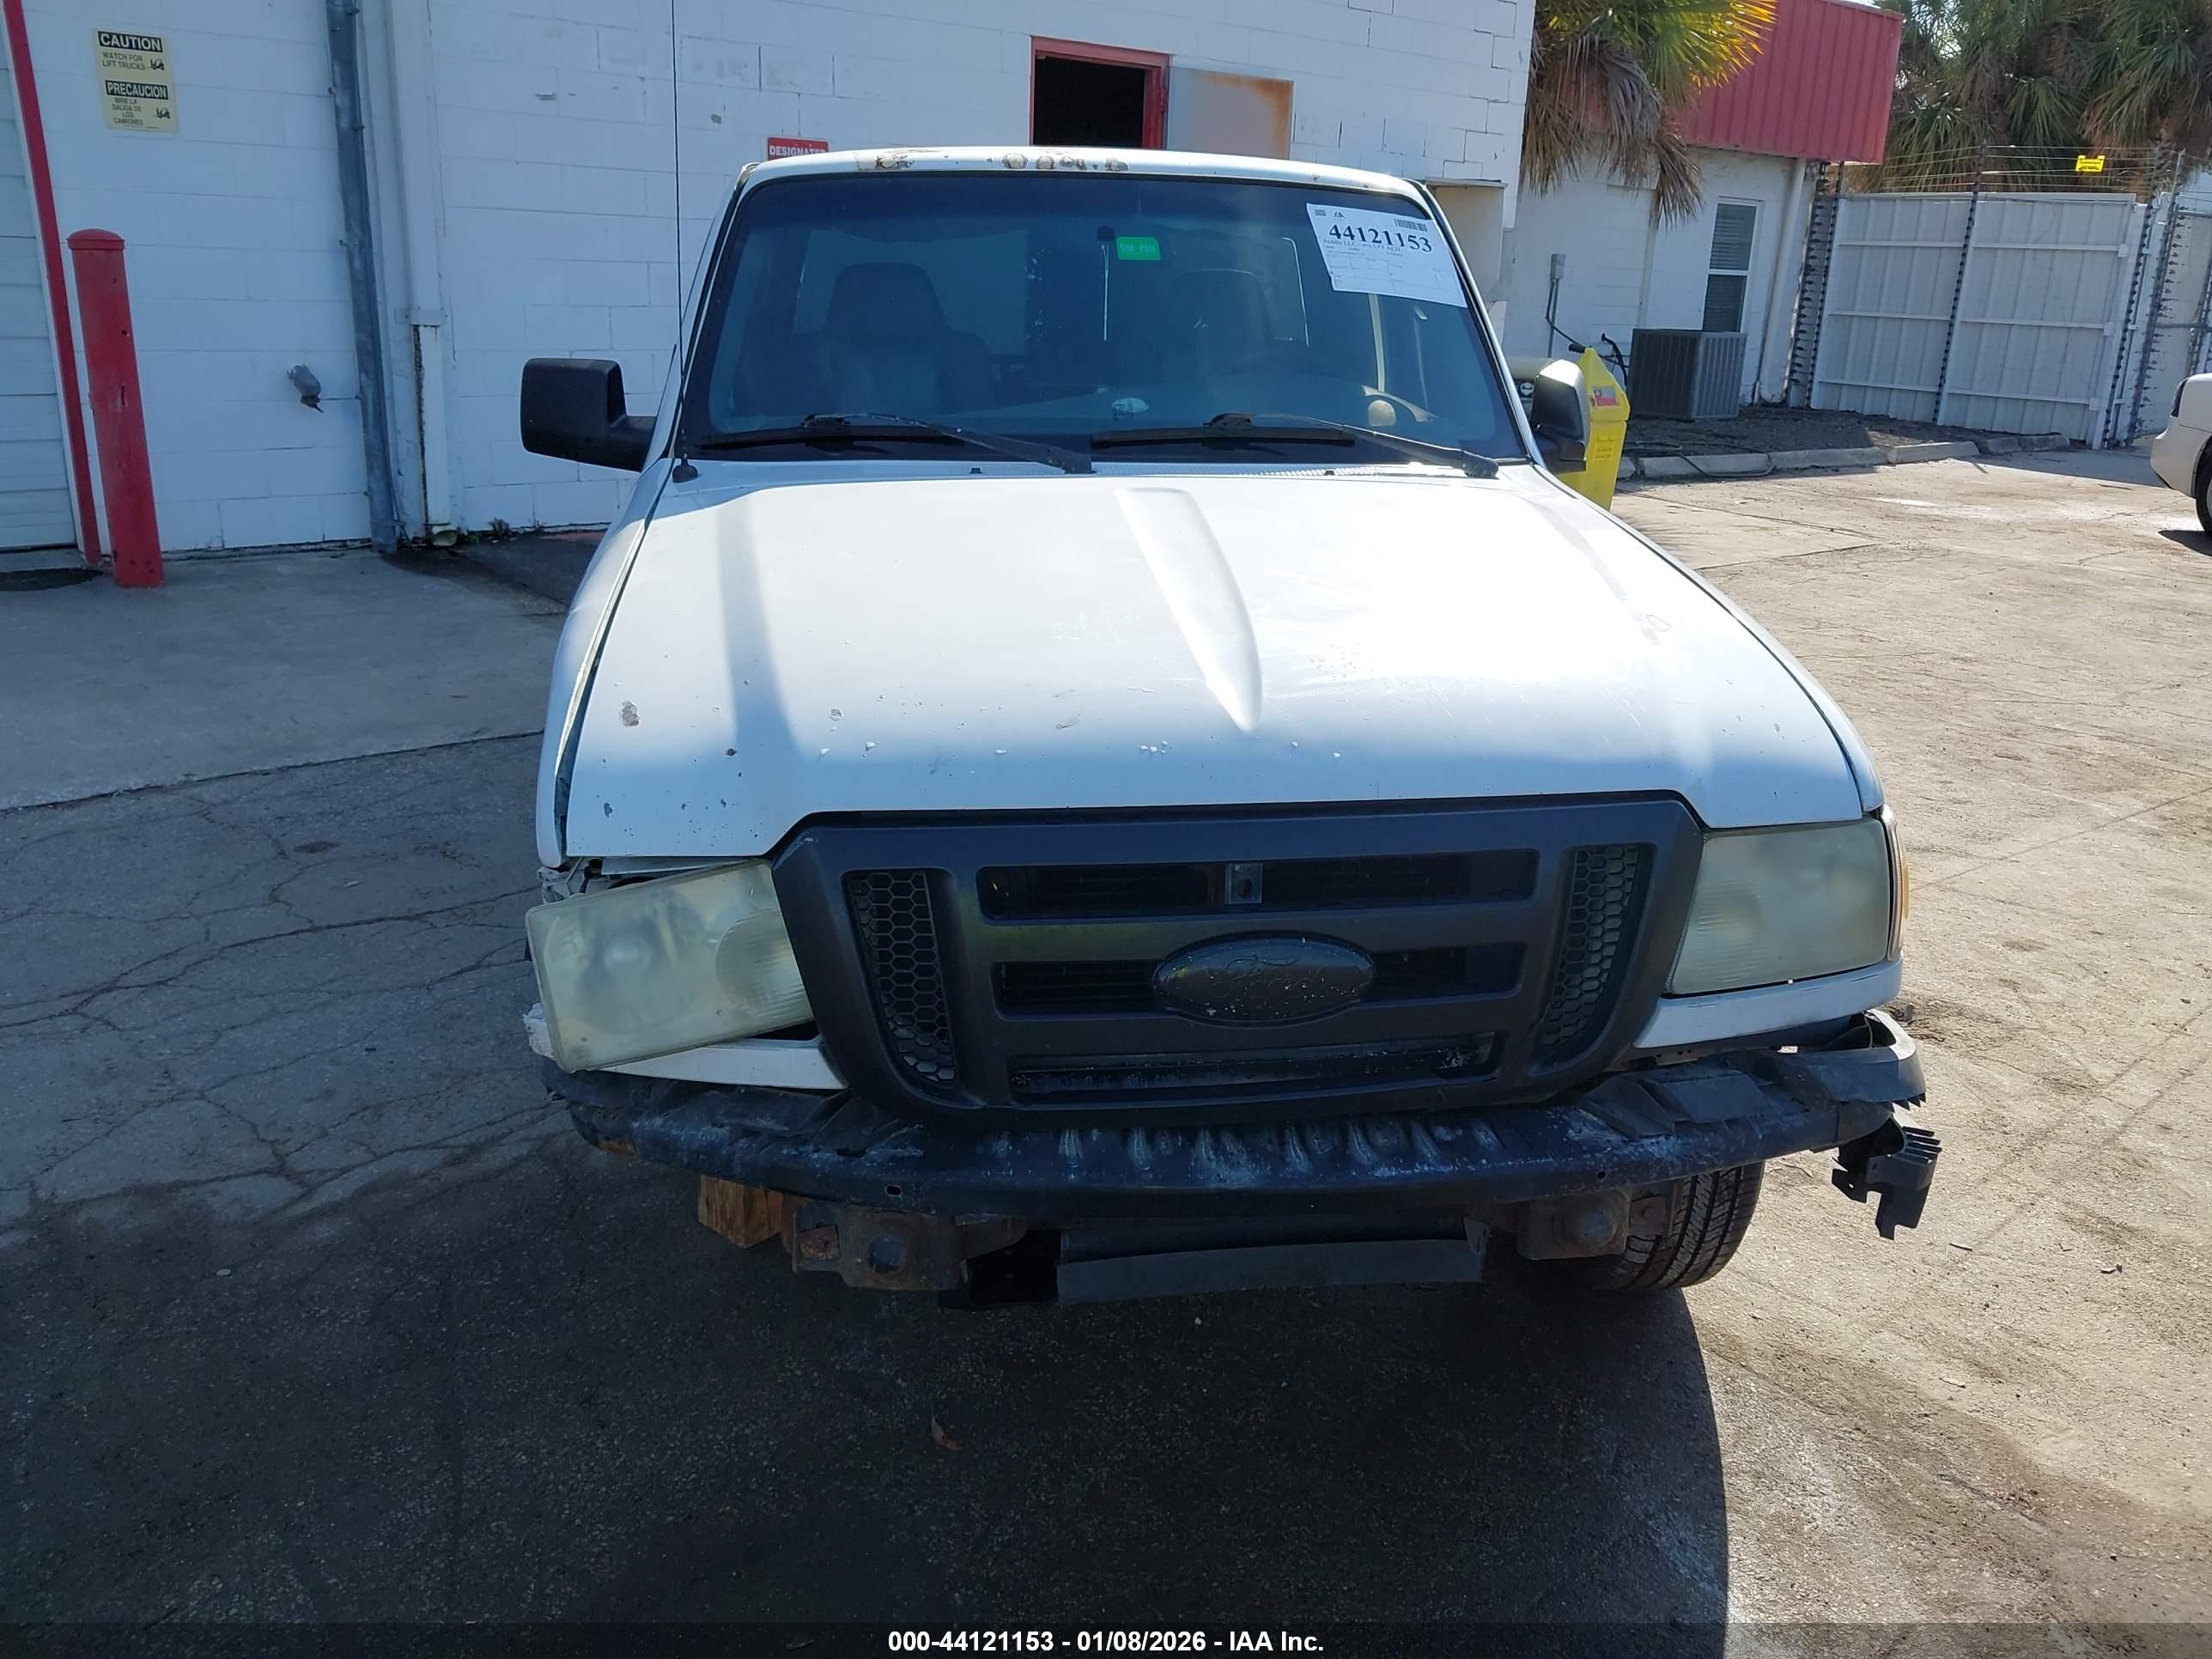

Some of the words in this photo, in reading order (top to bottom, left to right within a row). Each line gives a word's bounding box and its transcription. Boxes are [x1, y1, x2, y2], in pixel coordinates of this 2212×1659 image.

[100, 33, 161, 52] CAUTION
[118, 61, 145, 70] TRUCKS
[107, 82, 167, 98] PRECAUCION
[1328, 223, 1432, 252] 44121153
